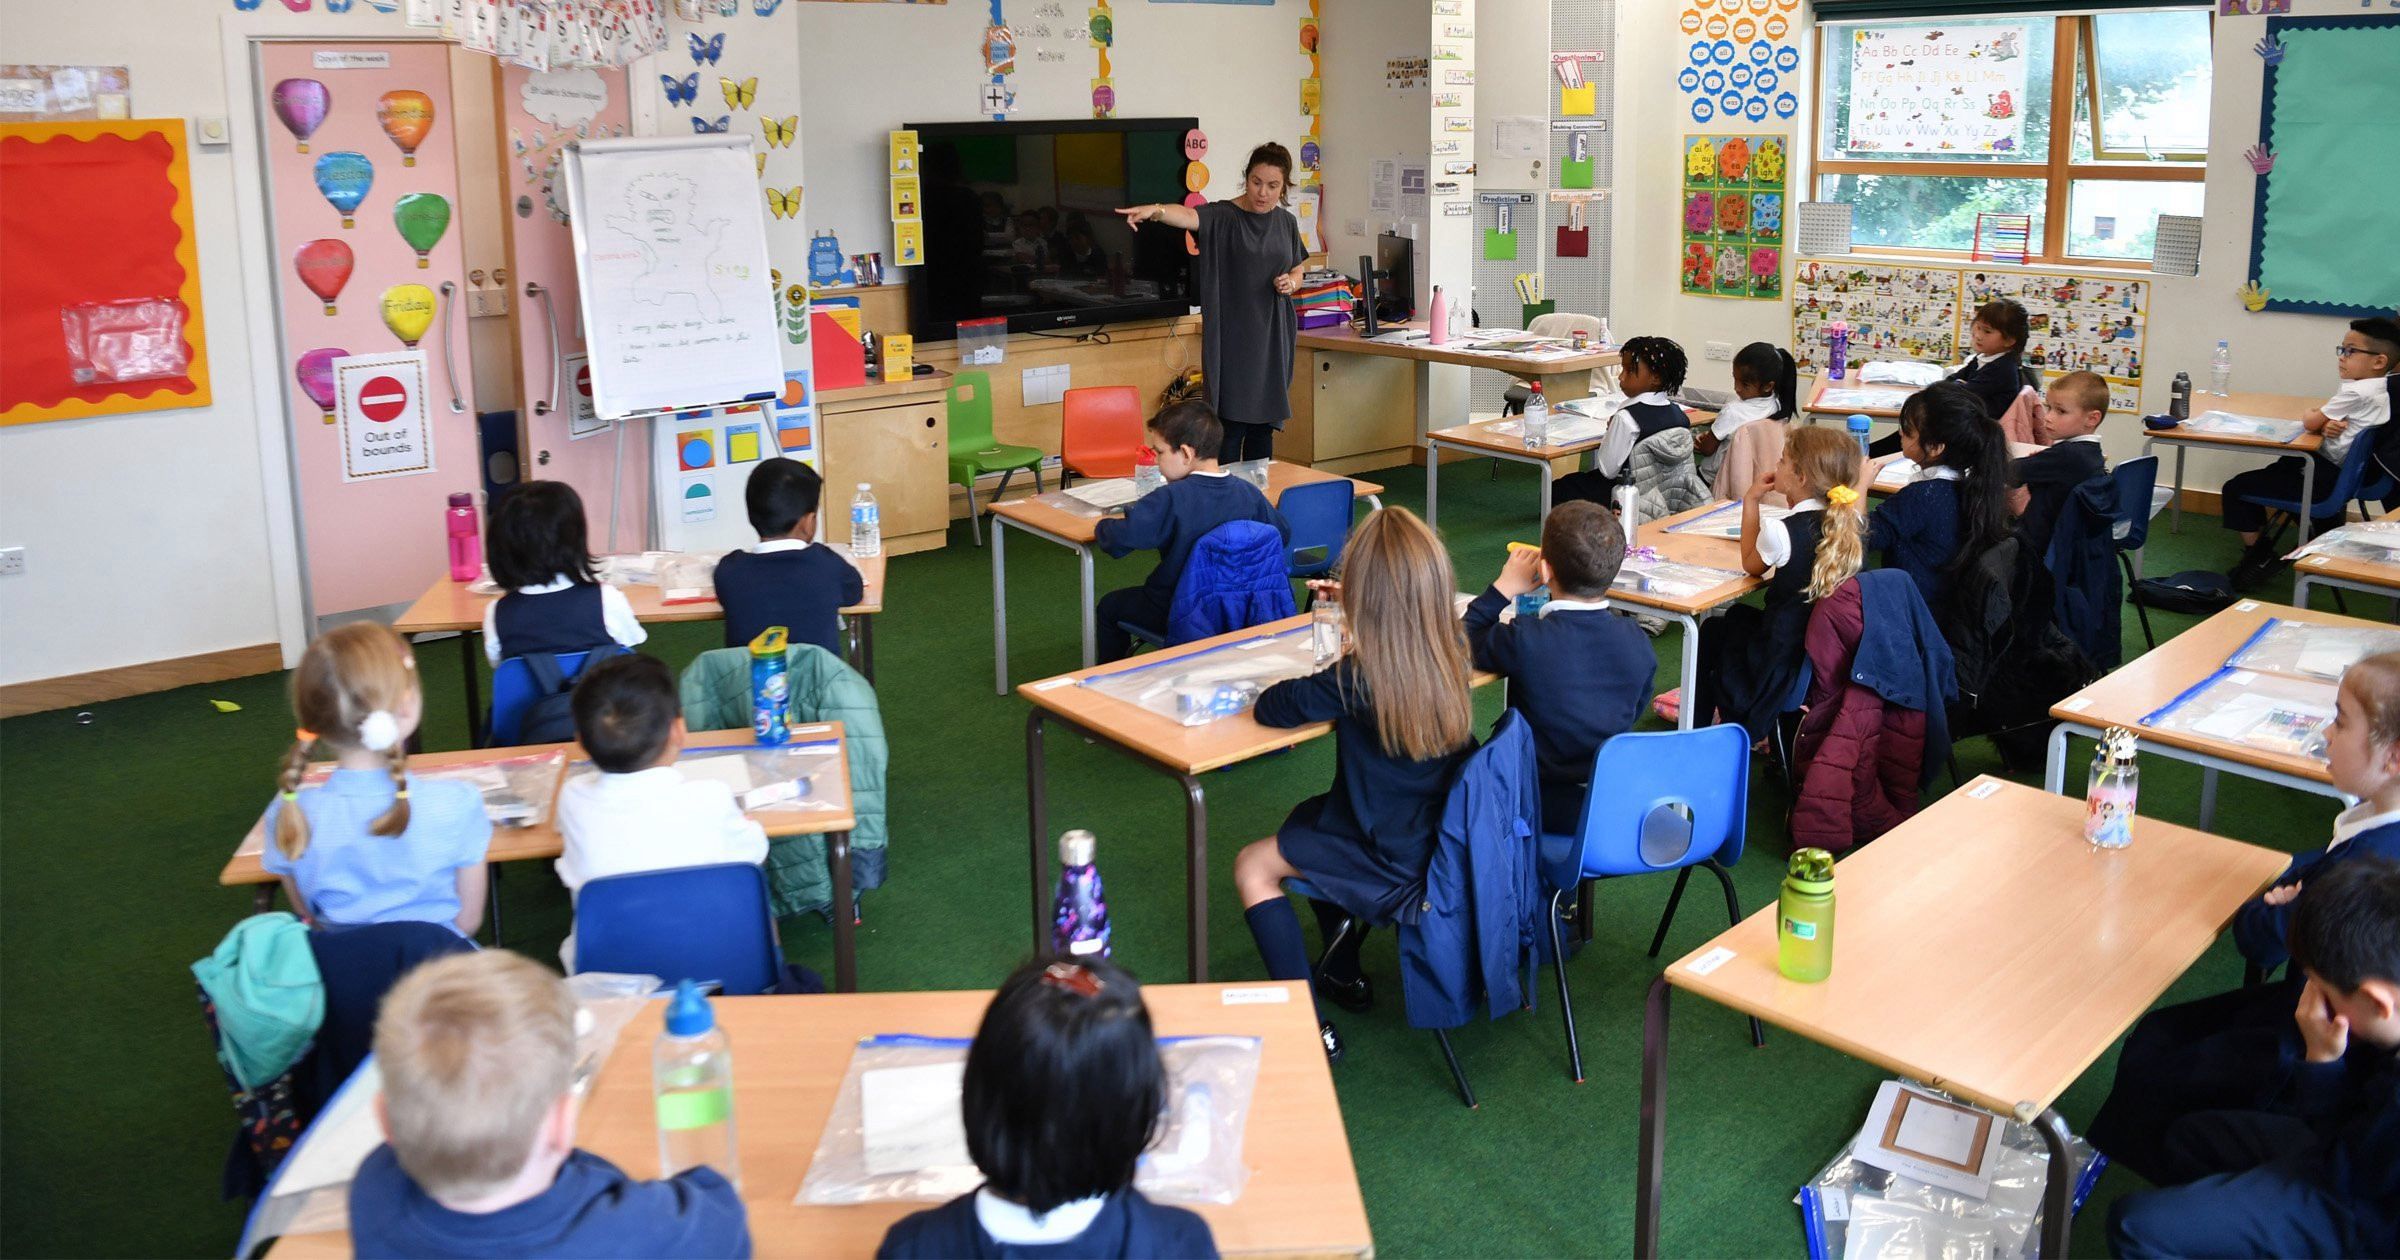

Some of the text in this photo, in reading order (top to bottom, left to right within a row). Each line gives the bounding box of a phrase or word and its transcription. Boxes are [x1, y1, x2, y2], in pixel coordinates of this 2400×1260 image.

[1862, 44, 1960, 58] Aa Bb Cc Dd Ee
[1782, 54, 1792, 62] he
[1697, 106, 1709, 114] she
[1780, 101, 1792, 109] the
[1860, 98, 1976, 112] Nn Oo Pp Qq Rr Ss
[1859, 124, 1998, 140] Tt Uu Vv Ww Xx Yy Zz
[1186, 138, 1207, 150] ABC
[1701, 156, 1711, 165] ay
[1760, 170, 1773, 178] igh
[1482, 195, 1520, 204] Predicting
[1725, 269, 1736, 279] oy
[384, 299, 432, 315] Friday
[2110, 397, 2136, 409] Yy Zz
[364, 428, 409, 443] Out of
[362, 442, 413, 458] bounds
